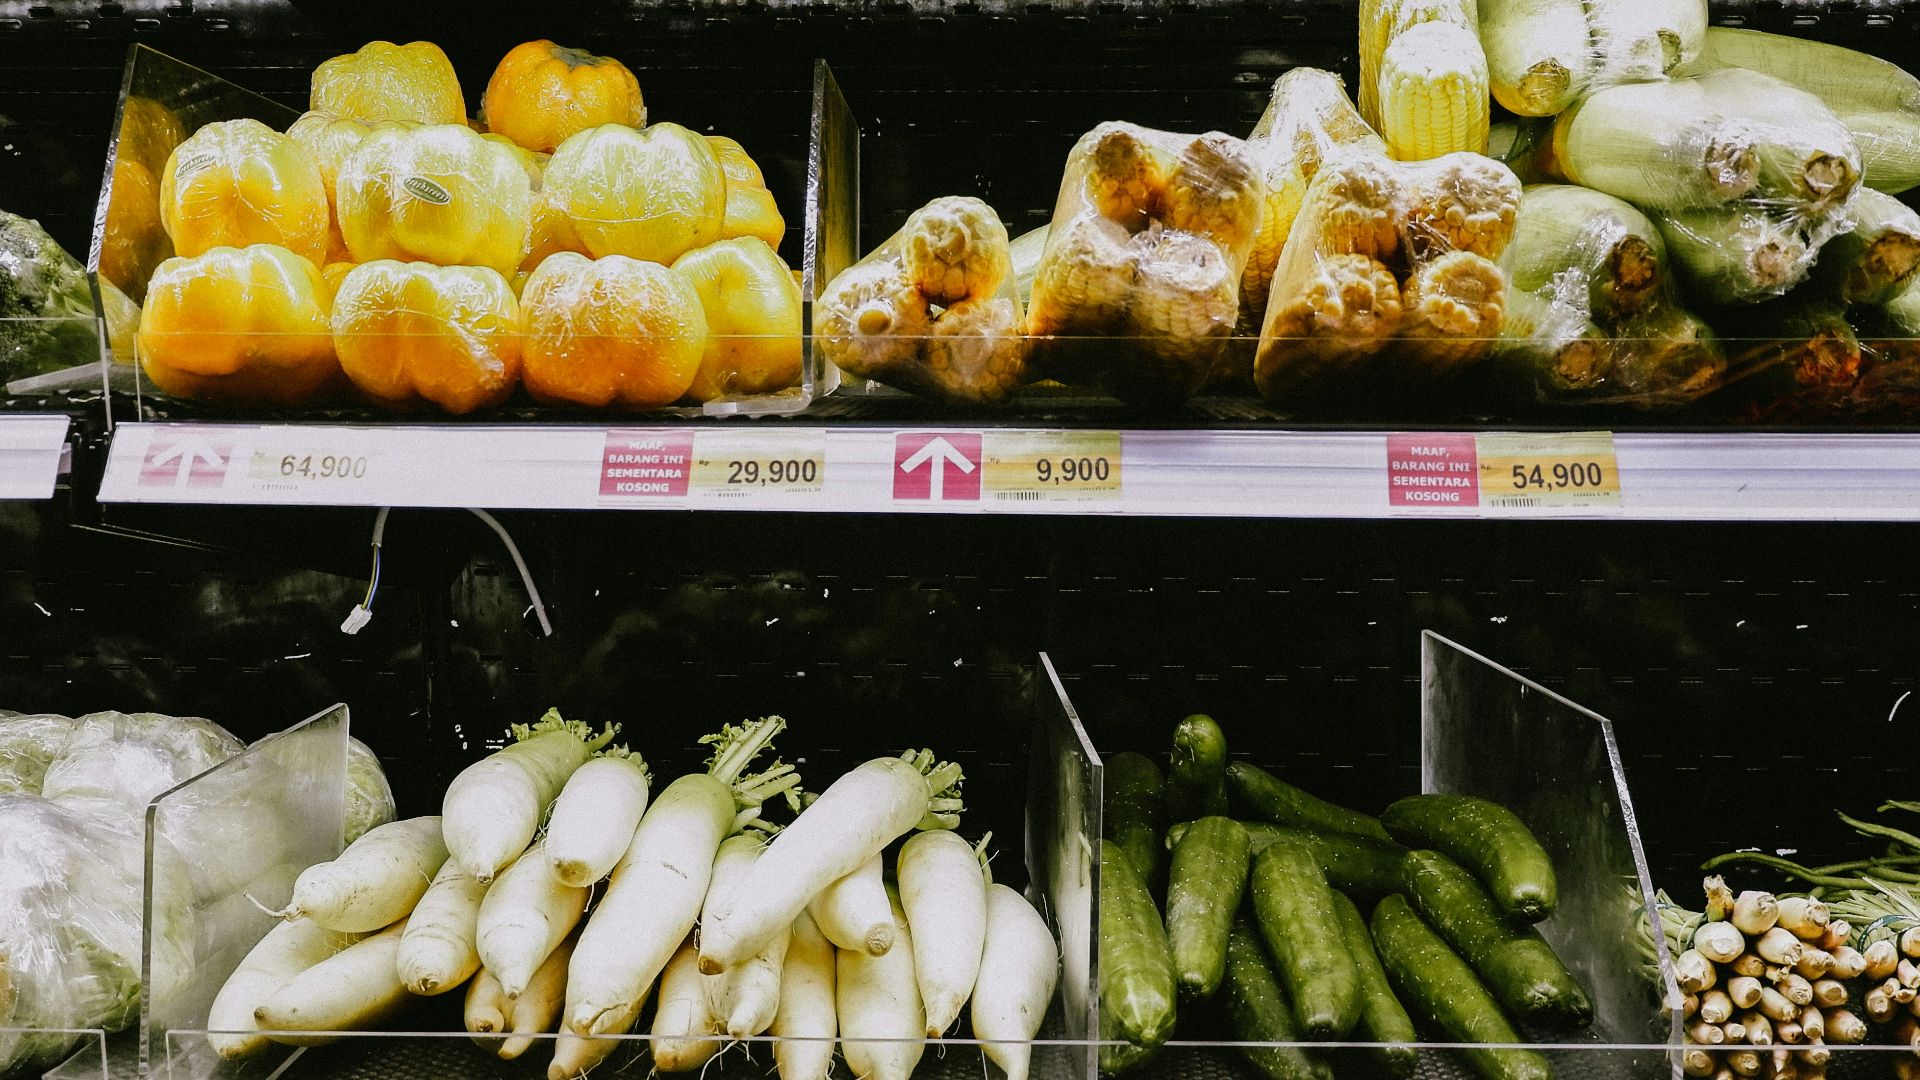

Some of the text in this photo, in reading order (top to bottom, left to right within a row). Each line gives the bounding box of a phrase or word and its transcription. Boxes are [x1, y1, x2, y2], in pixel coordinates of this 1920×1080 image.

[628, 441, 666, 452] MAAF,
[1411, 446, 1450, 459] MAAF,
[608, 454, 684, 465] BARANG INI
[280, 454, 367, 480] 64,900
[607, 468, 682, 478] SEMENTARA
[728, 459, 816, 487] 29,900
[1036, 457, 1110, 485] 9,900
[1392, 461, 1471, 473] BARANG INI
[1393, 476, 1471, 488] SEMENTARA
[1512, 462, 1602, 492] 54,900
[616, 483, 670, 493] KOSONG
[1405, 491, 1460, 502] KOSONG
